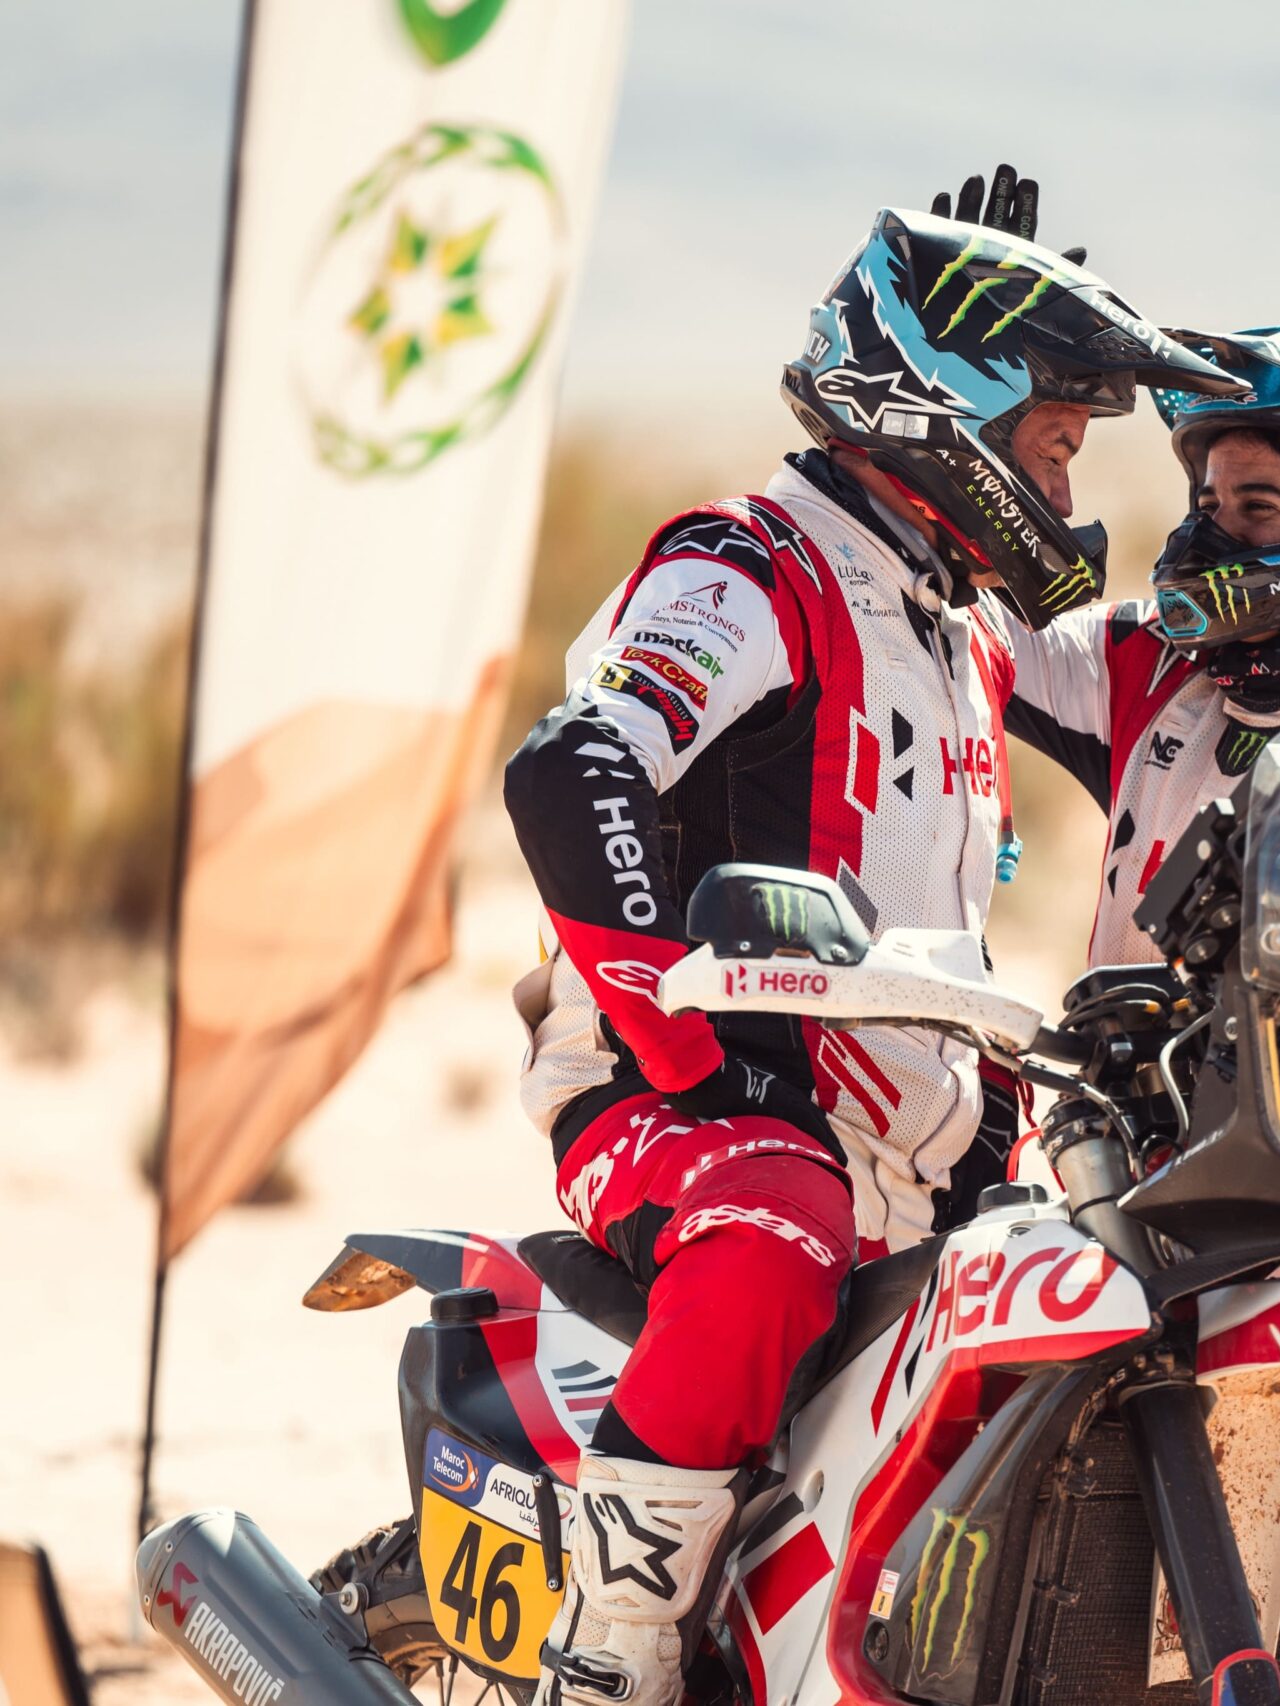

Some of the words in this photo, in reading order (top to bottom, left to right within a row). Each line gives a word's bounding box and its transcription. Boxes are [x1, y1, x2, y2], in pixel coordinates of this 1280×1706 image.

[997, 176, 1009, 197] ONE
[993, 197, 1006, 228] VISION
[1022, 193, 1034, 214] ONE
[966, 484, 1020, 552] ENERGY
[633, 631, 725, 680] mackair
[592, 797, 657, 927] Hero
[759, 971, 828, 995] Hero
[728, 1138, 833, 1162] Hero
[677, 1203, 836, 1267] astars
[925, 1246, 1120, 1353] Hero
[432, 1456, 463, 1484] Telecom
[441, 1446, 465, 1470] Maroc
[490, 1478, 539, 1513] AFRIQU
[439, 1520, 526, 1663] 46
